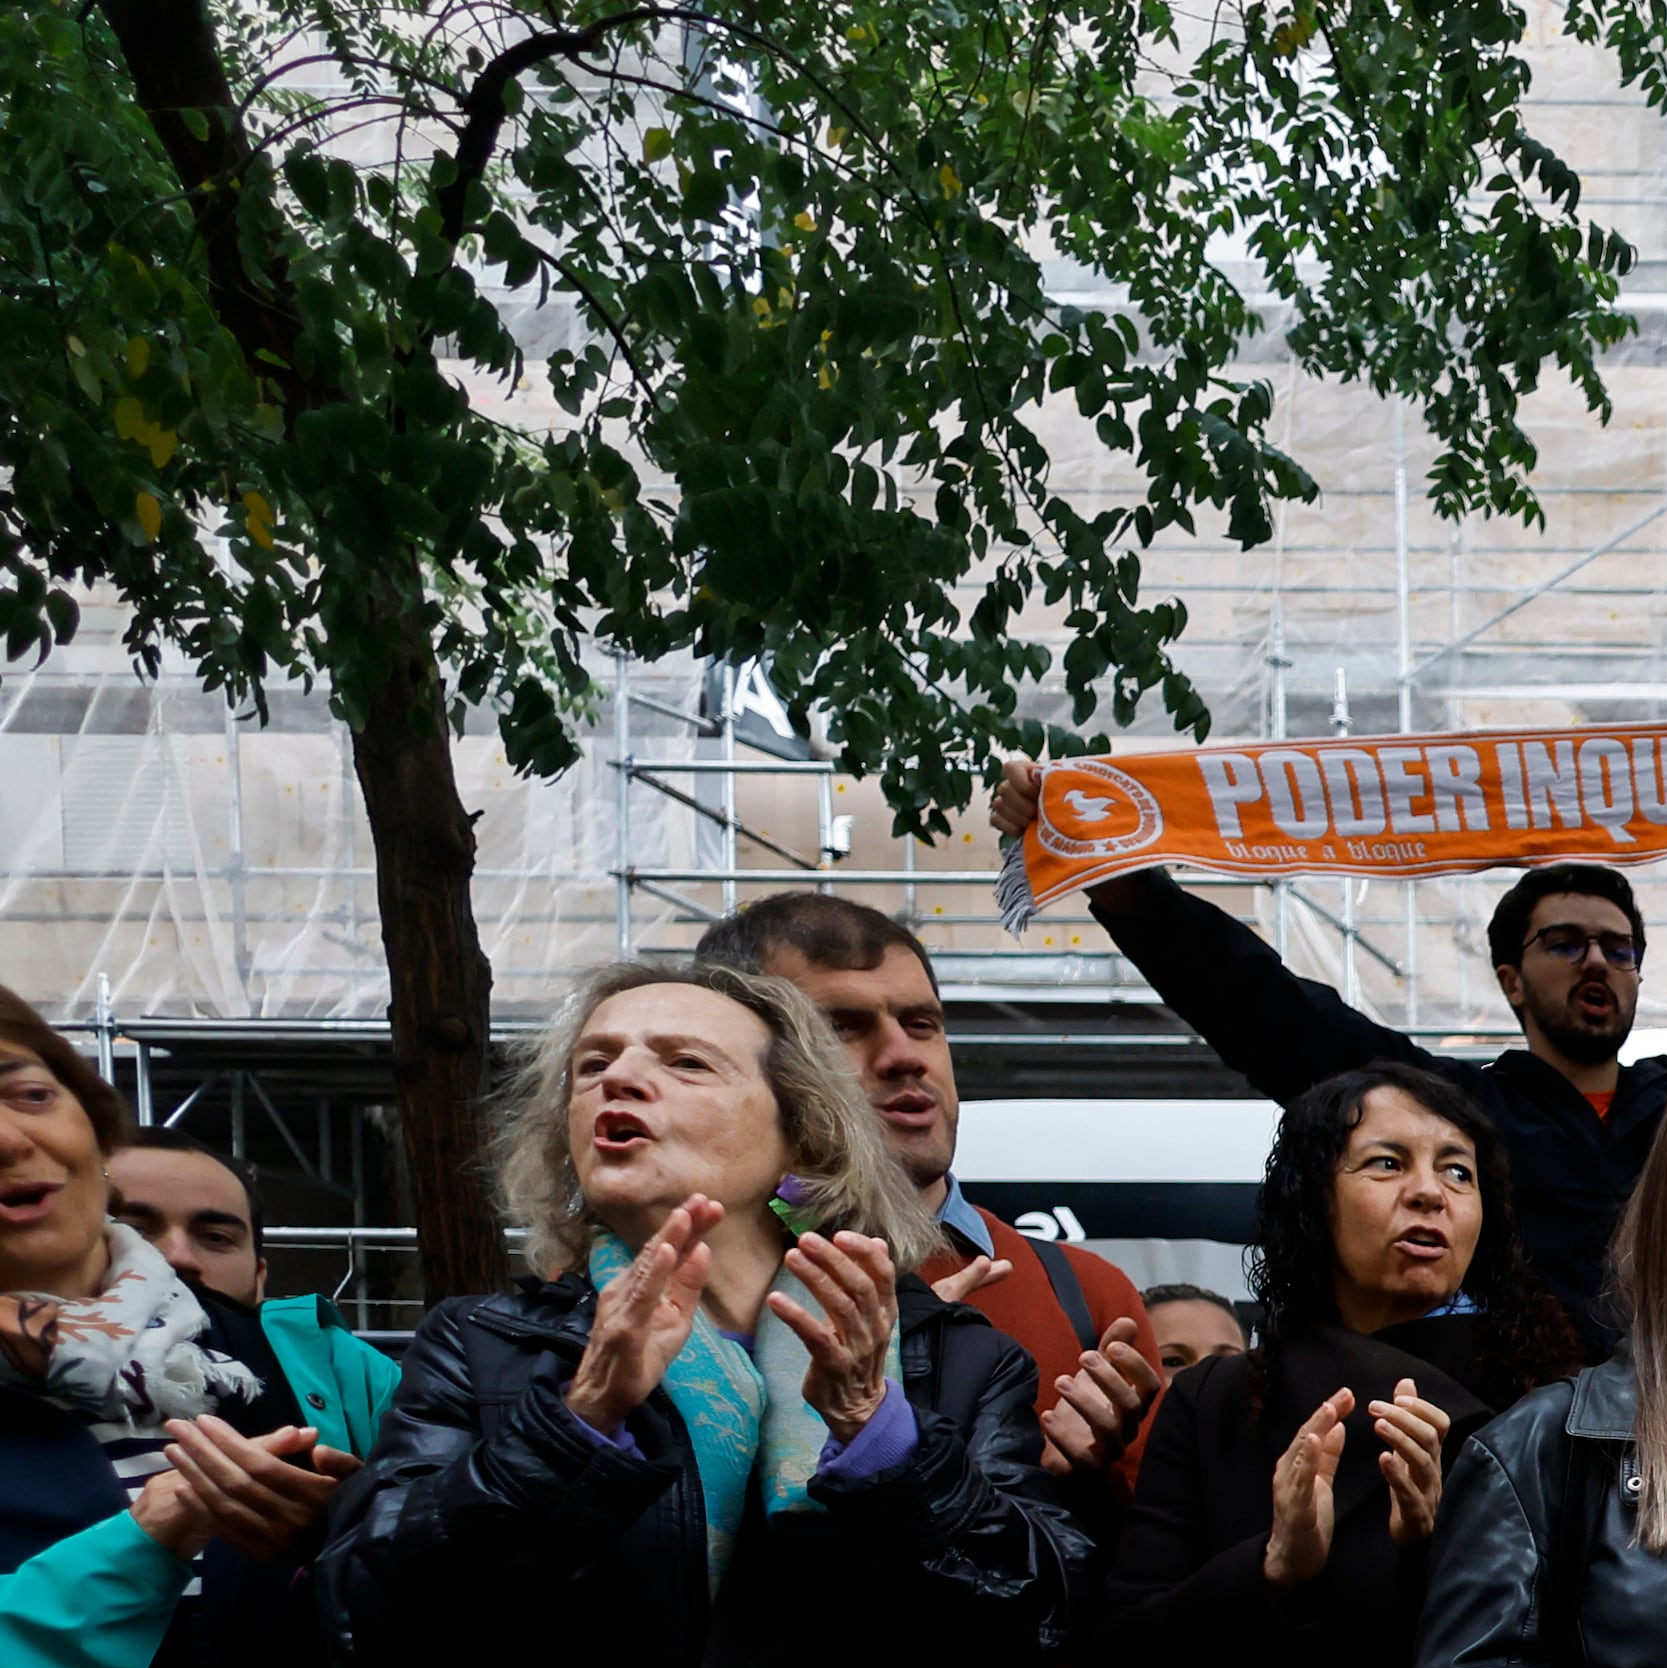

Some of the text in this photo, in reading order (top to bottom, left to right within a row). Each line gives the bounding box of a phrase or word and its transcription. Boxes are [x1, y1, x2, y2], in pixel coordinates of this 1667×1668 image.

[1195, 744, 1490, 840] PODER
[1226, 840, 1428, 864] bloque a bloque
